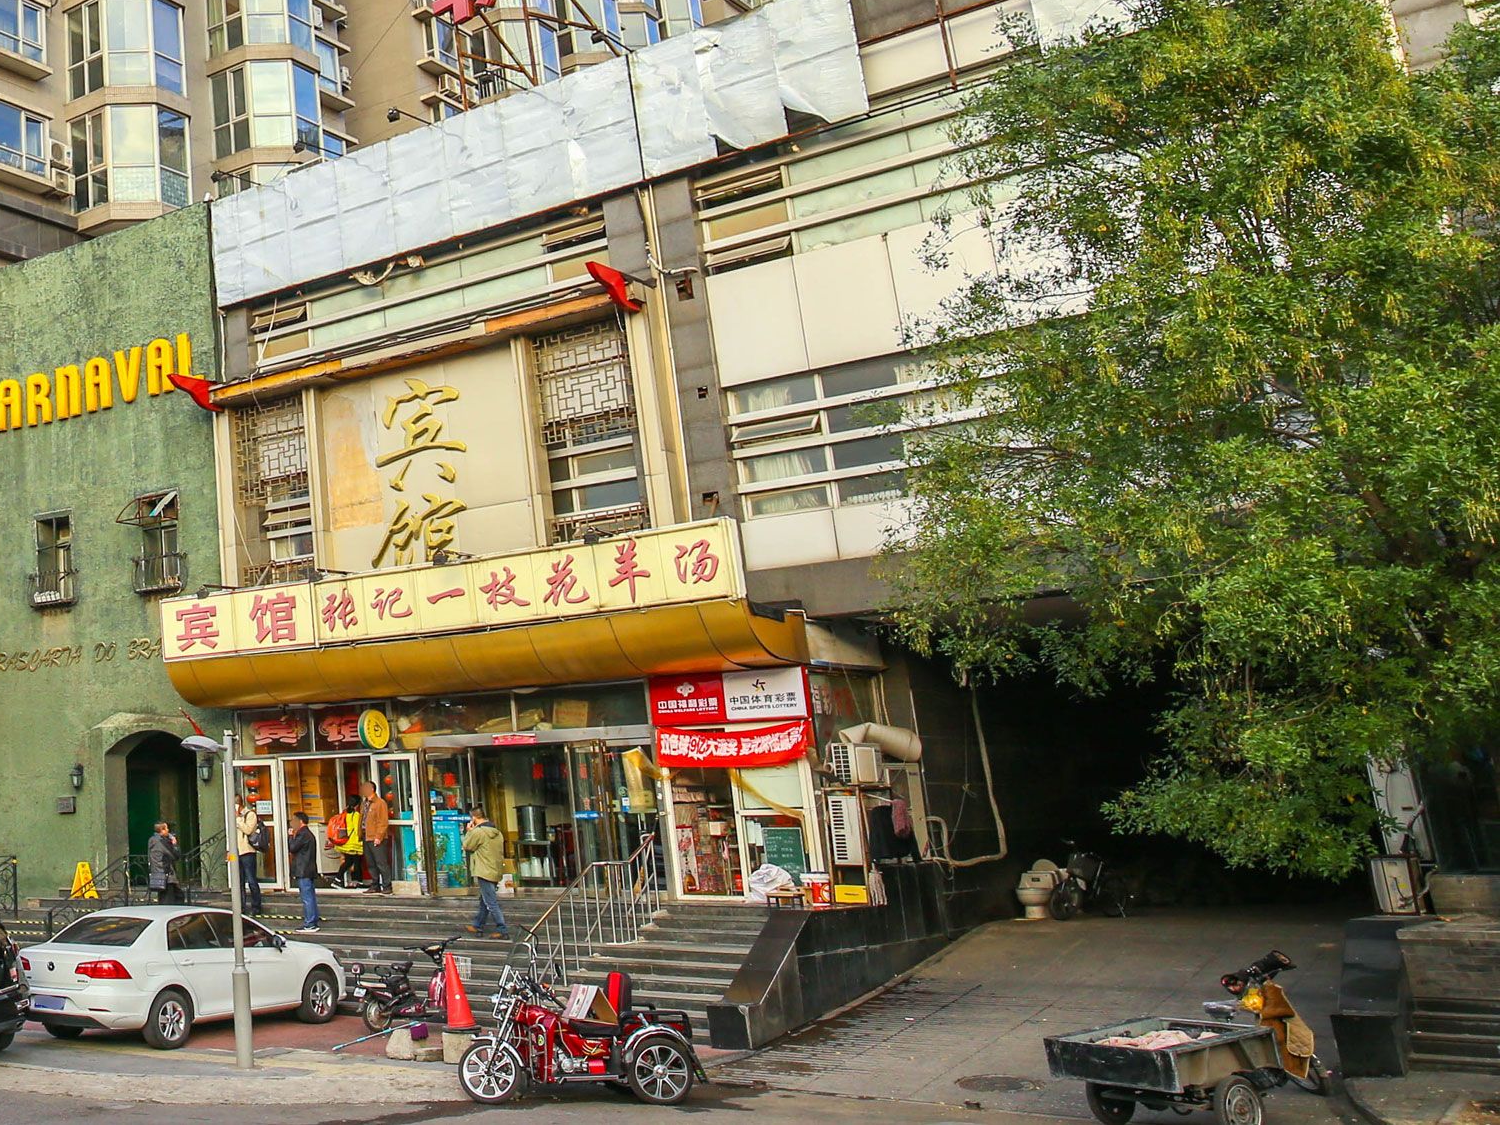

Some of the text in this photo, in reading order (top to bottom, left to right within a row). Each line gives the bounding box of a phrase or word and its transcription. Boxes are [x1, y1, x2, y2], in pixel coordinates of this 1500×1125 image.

[371, 377, 468, 569] 宾馆
[175, 538, 720, 652] 宾馆 张记一枝花羊汤
[94, 640, 117, 663] DO
[729, 691, 797, 705] 中国体育彩票
